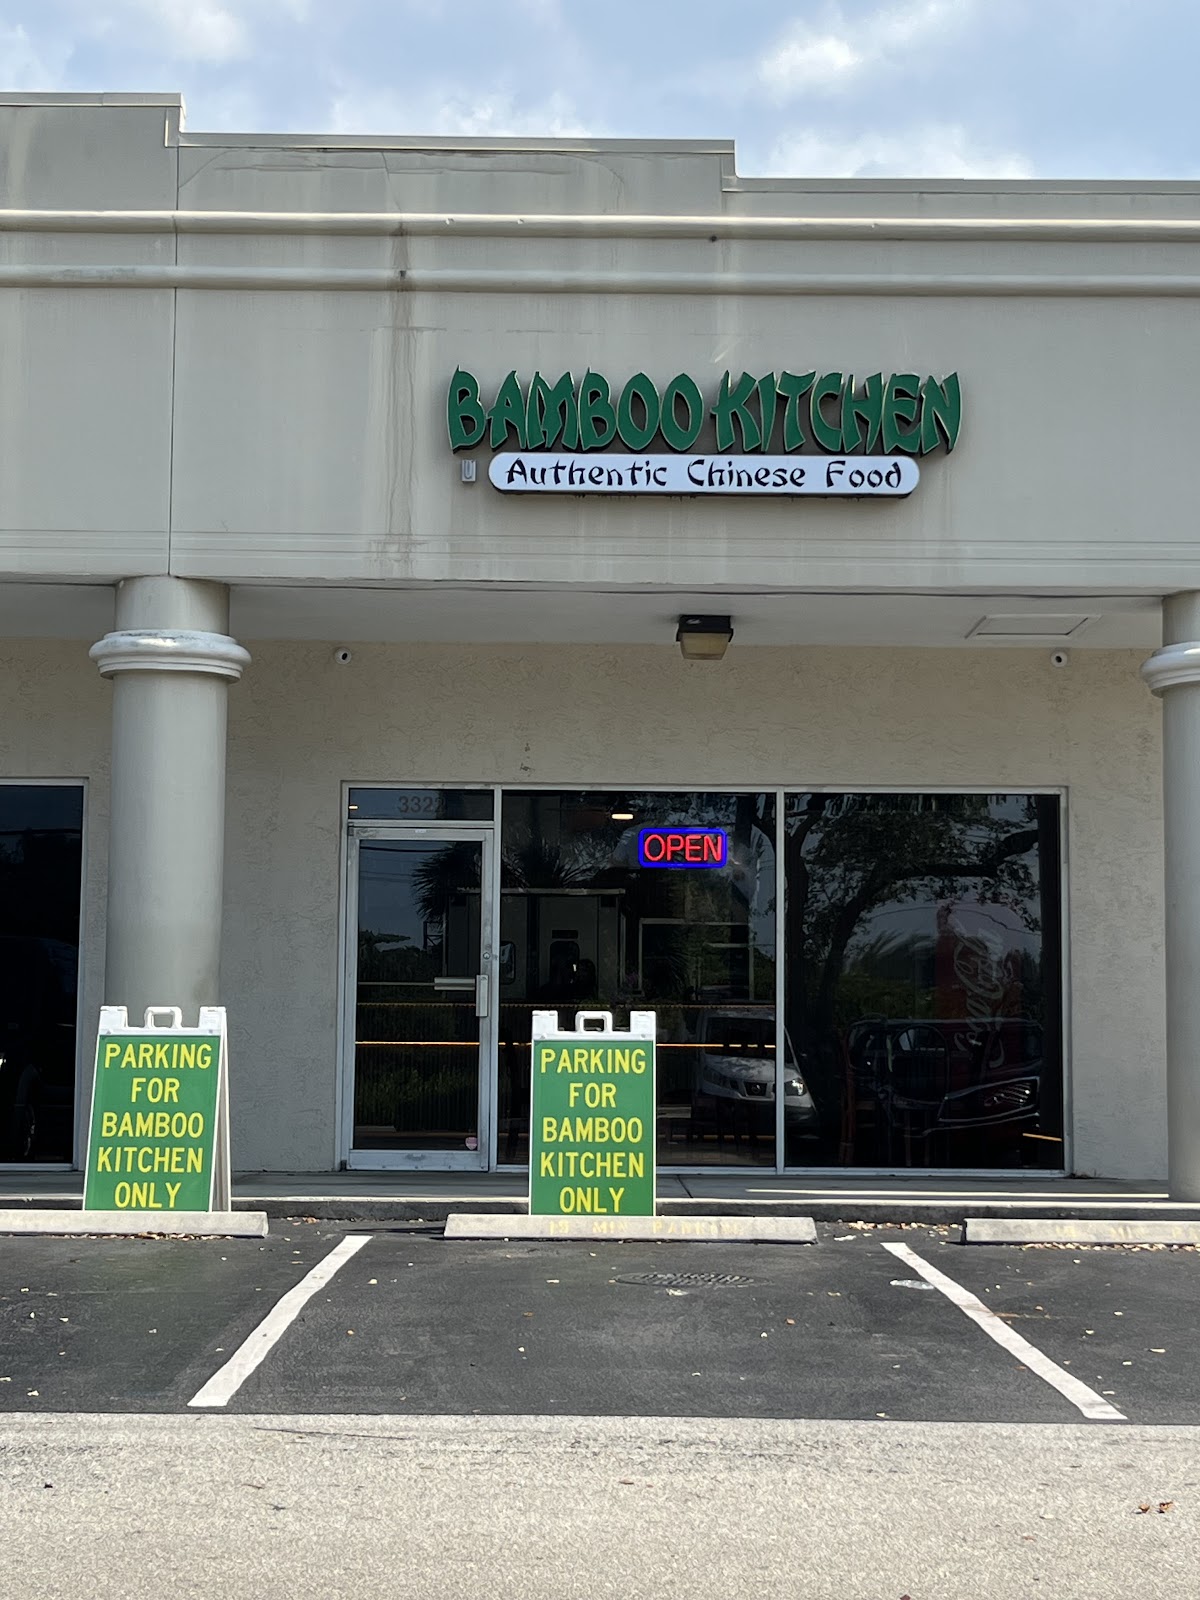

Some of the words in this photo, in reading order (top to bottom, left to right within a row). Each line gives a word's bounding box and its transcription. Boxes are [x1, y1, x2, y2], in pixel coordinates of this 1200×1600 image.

[447, 366, 704, 453] BAMBOO
[710, 370, 963, 455] KITCHEN
[506, 456, 668, 488] Authentic
[685, 458, 807, 488] Chinese
[825, 459, 903, 489] Food
[644, 834, 722, 862] OPEN
[104, 1043, 212, 1069] PARKING
[540, 1048, 646, 1074] PARKING
[130, 1077, 180, 1103] FOR
[569, 1082, 617, 1108] FOR
[101, 1112, 204, 1138] BAMBOO
[542, 1117, 643, 1143] BAMBOO
[97, 1147, 203, 1173] KITCHEN
[540, 1152, 645, 1178] KITCHEN
[114, 1181, 182, 1208] ONLY
[559, 1186, 625, 1213] ONLY
